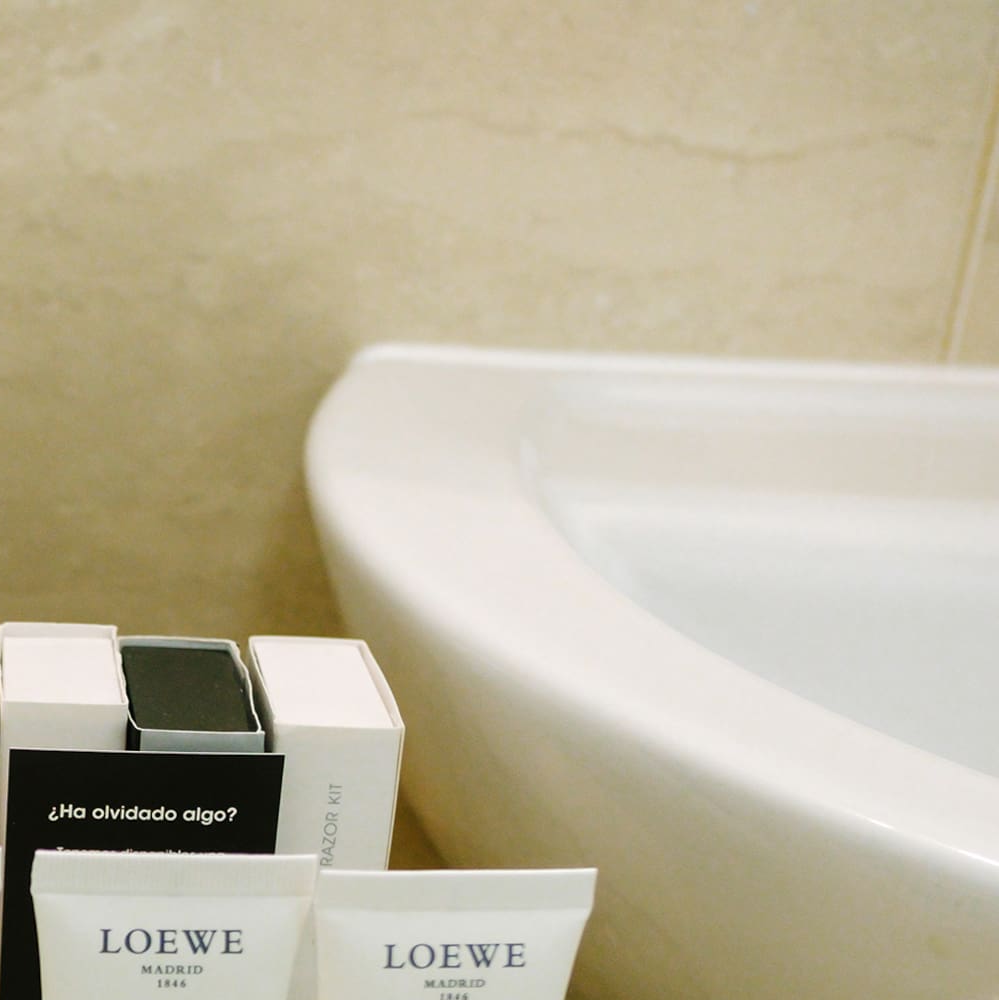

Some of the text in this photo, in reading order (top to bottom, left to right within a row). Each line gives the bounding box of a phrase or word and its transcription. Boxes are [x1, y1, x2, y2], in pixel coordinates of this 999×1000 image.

[48, 803, 238, 826] ¿Ha olvidado algo?
[320, 783, 343, 866] RAZOR KIT
[99, 928, 244, 955] LOEWE
[383, 943, 526, 969] LOEWE
[141, 965, 204, 975] MADRID
[157, 979, 187, 988] 1846
[424, 979, 486, 988] MADRID
